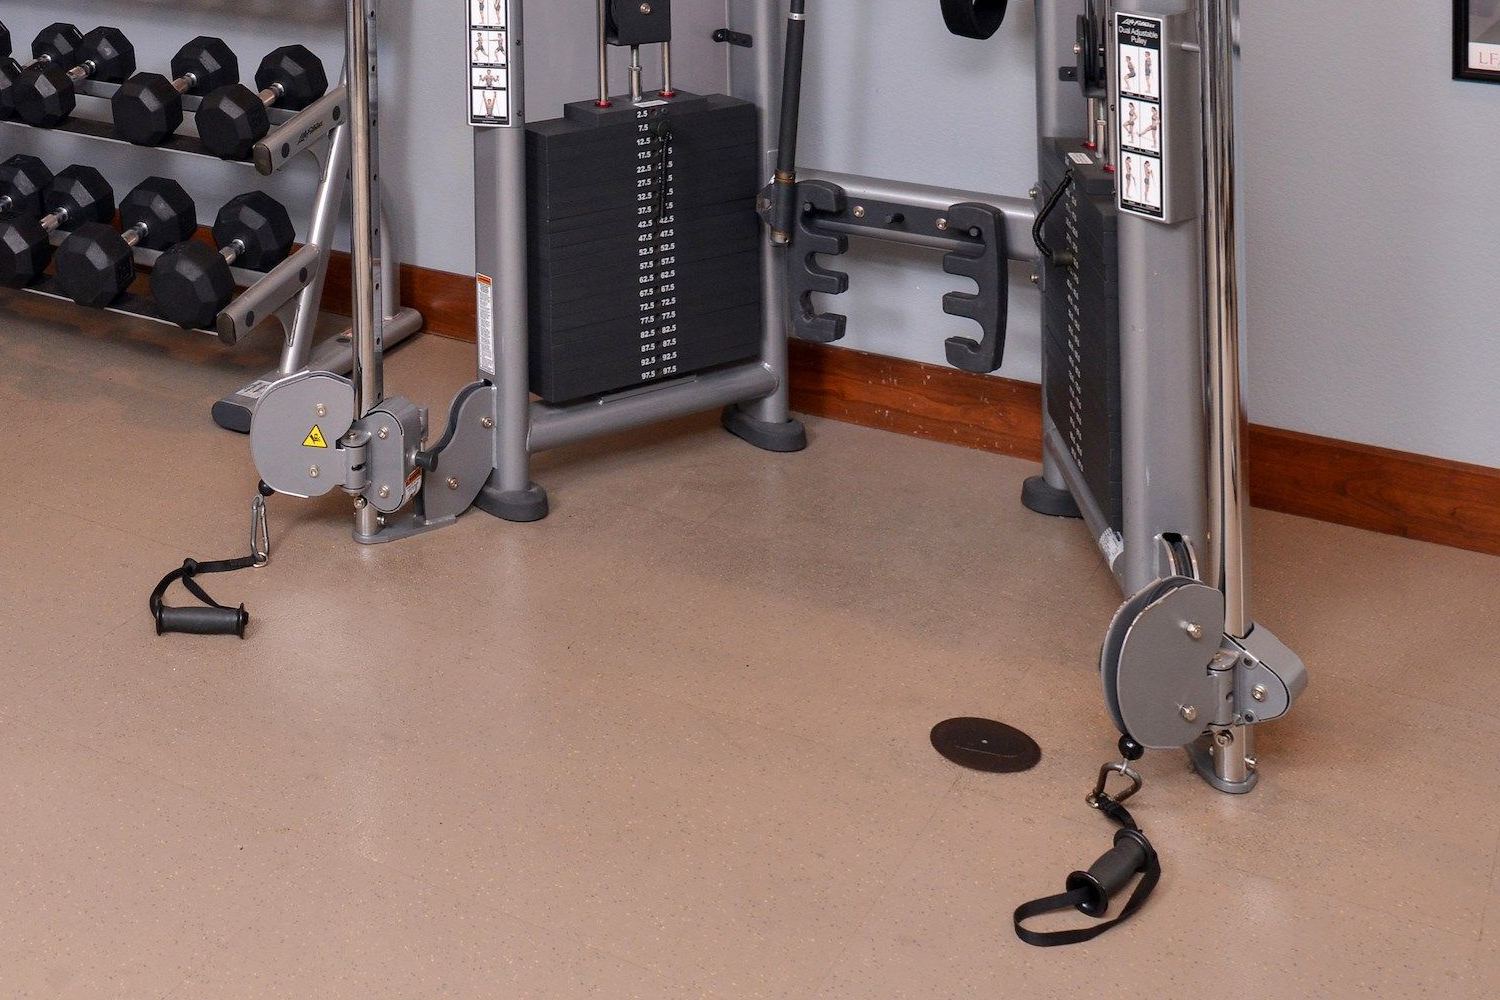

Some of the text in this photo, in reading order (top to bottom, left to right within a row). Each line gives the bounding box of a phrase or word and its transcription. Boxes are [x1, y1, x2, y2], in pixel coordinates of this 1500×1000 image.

[637, 110, 648, 118] 2.5
[637, 137, 651, 145] 12.5
[638, 151, 651, 159] 17.5
[637, 165, 651, 173] 22.5
[637, 179, 651, 187] 27.5
[637, 192, 652, 201] 32.5
[638, 206, 651, 214] 37.5
[638, 220, 652, 228] 42.5
[638, 229, 674, 242] 47.5 47.5
[639, 243, 675, 256] 52.5 52.5
[640, 257, 675, 269] 57.5 57.5
[639, 270, 675, 283] 62.5 62.5
[640, 284, 675, 297] 67.5 67.5
[640, 297, 676, 311] 72.5 72.5
[640, 311, 676, 324] 77.5 77.5
[640, 325, 676, 338] 82.5 82.5
[641, 338, 676, 352] 87.5 87.5
[641, 352, 677, 366] 92.5 92.5
[642, 366, 676, 380] 97.5 97.5
